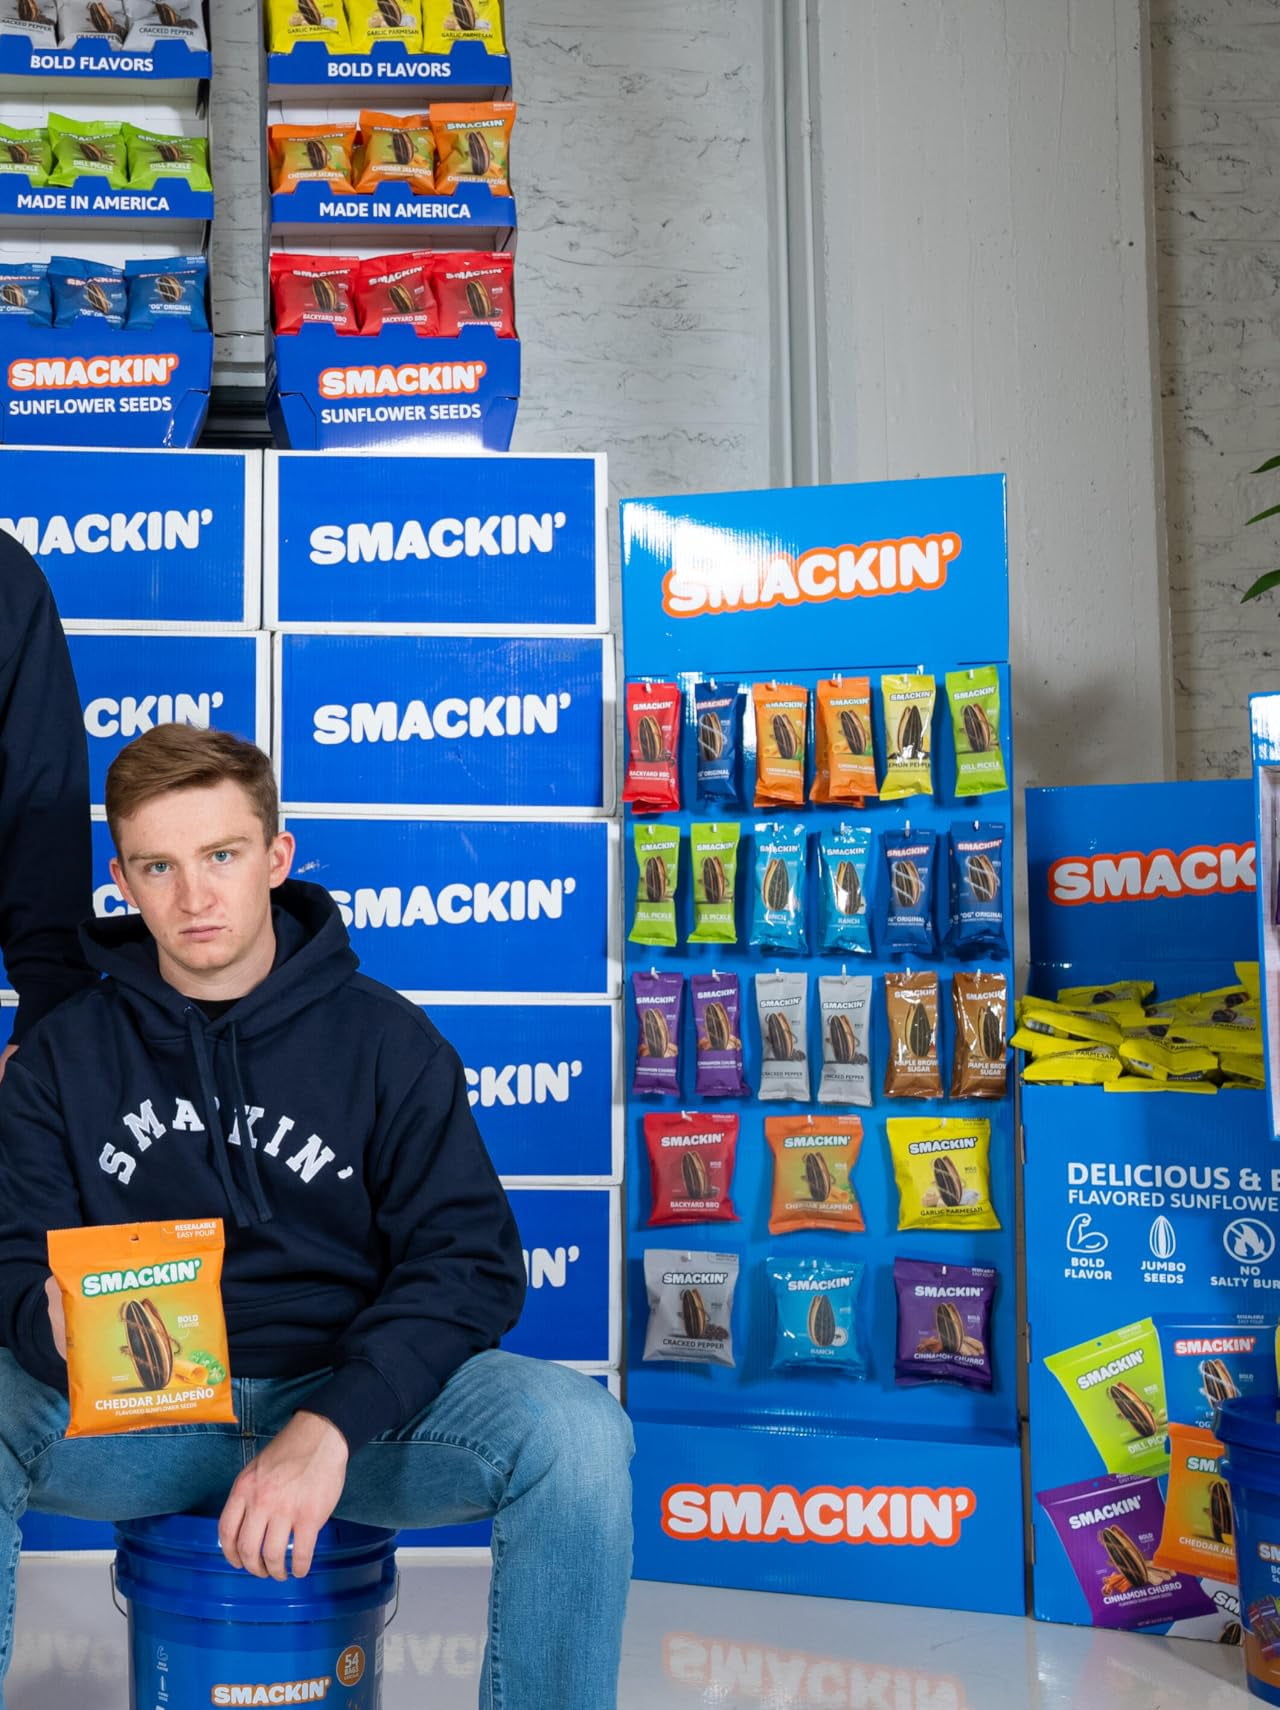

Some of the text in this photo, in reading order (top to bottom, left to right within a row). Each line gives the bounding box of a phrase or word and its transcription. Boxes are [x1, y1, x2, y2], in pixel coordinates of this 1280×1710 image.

[139, 27, 194, 37] CRACKED PEPPER
[30, 55, 153, 72] BOLD FLAVORS
[328, 63, 451, 77] BOLD FLAVORS
[17, 195, 169, 211] MADE IN AMERICA
[320, 202, 470, 218] MADE IN AMERICA
[11, 357, 175, 387] SMACKIN'
[322, 365, 483, 396] SMACKIN'
[9, 397, 172, 415] SUNFLOWER SEEDS
[321, 404, 481, 423] SUNFLOWER SEEDS
[310, 512, 567, 565] SMACKIN'
[669, 538, 955, 611] SMACKIN'
[83, 692, 223, 738] CKIN'
[313, 693, 571, 745] SMACKIN'
[1054, 847, 1256, 900] SMACK
[99, 1097, 354, 1184] SMAKIN'
[661, 1133, 725, 1147] SMACKIN'
[784, 1136, 851, 1148] SMACKIN'
[909, 1137, 977, 1155] SMACKIN'
[1068, 1163, 1231, 1190] DELICIOUS
[1239, 1168, 1261, 1191] &
[1068, 1190, 1279, 1212] FLAVORED SUNFLOWE
[175, 1222, 216, 1231] RESEALABLE
[177, 1231, 193, 1239] EASY
[1071, 1257, 1105, 1268] BOLD
[1140, 1261, 1187, 1272] JUMBO
[84, 1260, 200, 1296] SMACKIN'
[663, 1273, 728, 1285] SMACKIN'
[1064, 1268, 1112, 1280] FLAVOR
[1143, 1273, 1184, 1284] SEEDS
[1240, 1266, 1261, 1276] NO
[788, 1276, 853, 1291] SMACKIN'
[1210, 1276, 1280, 1289] SALTY BUR
[914, 1285, 984, 1297] SMACKIN'
[663, 1338, 724, 1349] CRACKED PEPPER
[1175, 1338, 1255, 1354] SMACKIN'
[1077, 1349, 1145, 1390] SMACKIN'
[96, 1387, 214, 1411] CHEDDAR JALAPEÑO
[1128, 1441, 1146, 1453] DILL
[668, 1491, 968, 1540] SMACKIN'
[1069, 1495, 1141, 1529] SMACKIN'
[1179, 1537, 1218, 1552] CHEDDAR
[1103, 1582, 1182, 1605] CINNAMON CHURRO
[345, 1653, 359, 1668] 54
[214, 1679, 330, 1705] SMACKIN'
